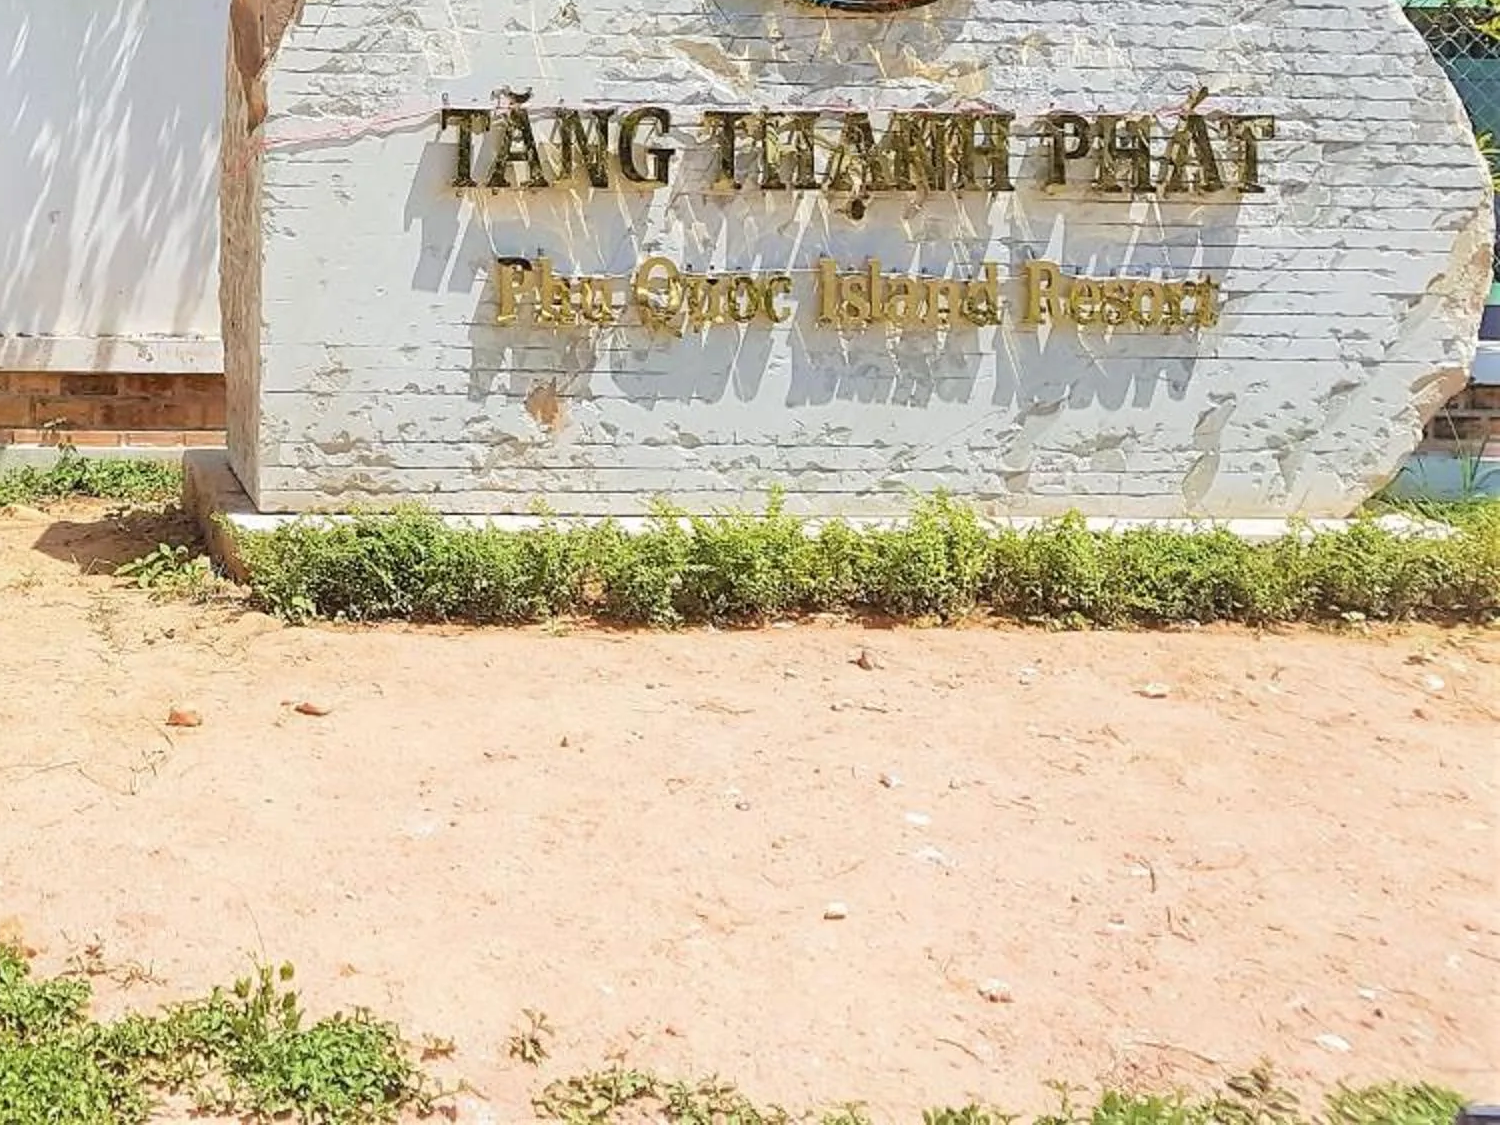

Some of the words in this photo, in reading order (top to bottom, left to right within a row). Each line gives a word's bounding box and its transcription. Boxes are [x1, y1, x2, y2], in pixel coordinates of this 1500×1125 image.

[1043, 87, 1275, 193] PHÁT
[633, 257, 793, 337] Quoc
[817, 258, 1000, 326] Island
[1023, 260, 1217, 328] Resort
